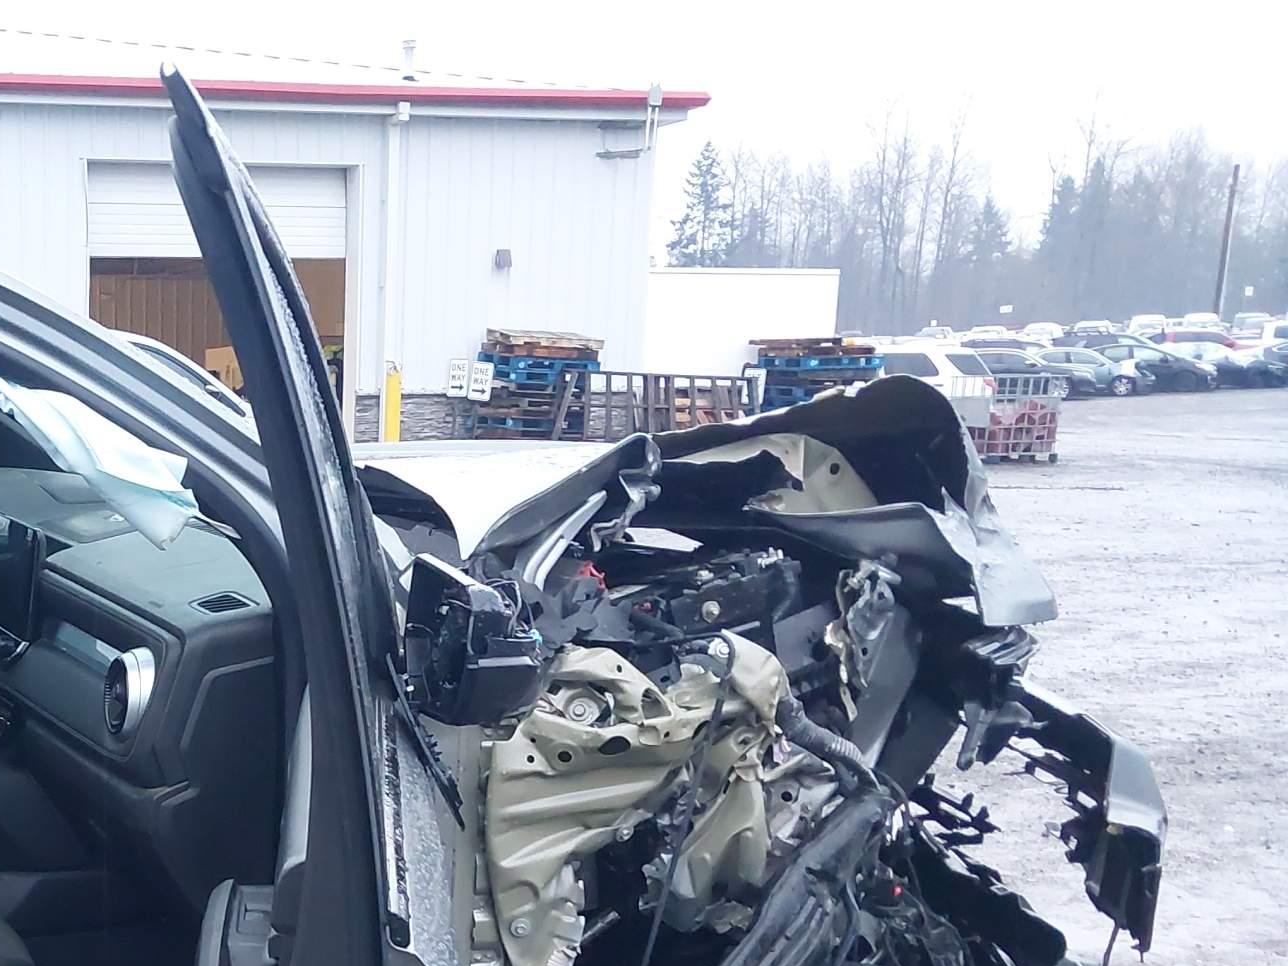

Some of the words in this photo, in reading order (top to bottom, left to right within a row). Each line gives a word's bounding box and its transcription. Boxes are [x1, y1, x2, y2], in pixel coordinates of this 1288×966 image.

[451, 362, 467, 372] ONE
[473, 367, 489, 377] ONE
[451, 374, 466, 382] WAY
[473, 377, 489, 386] WAY
